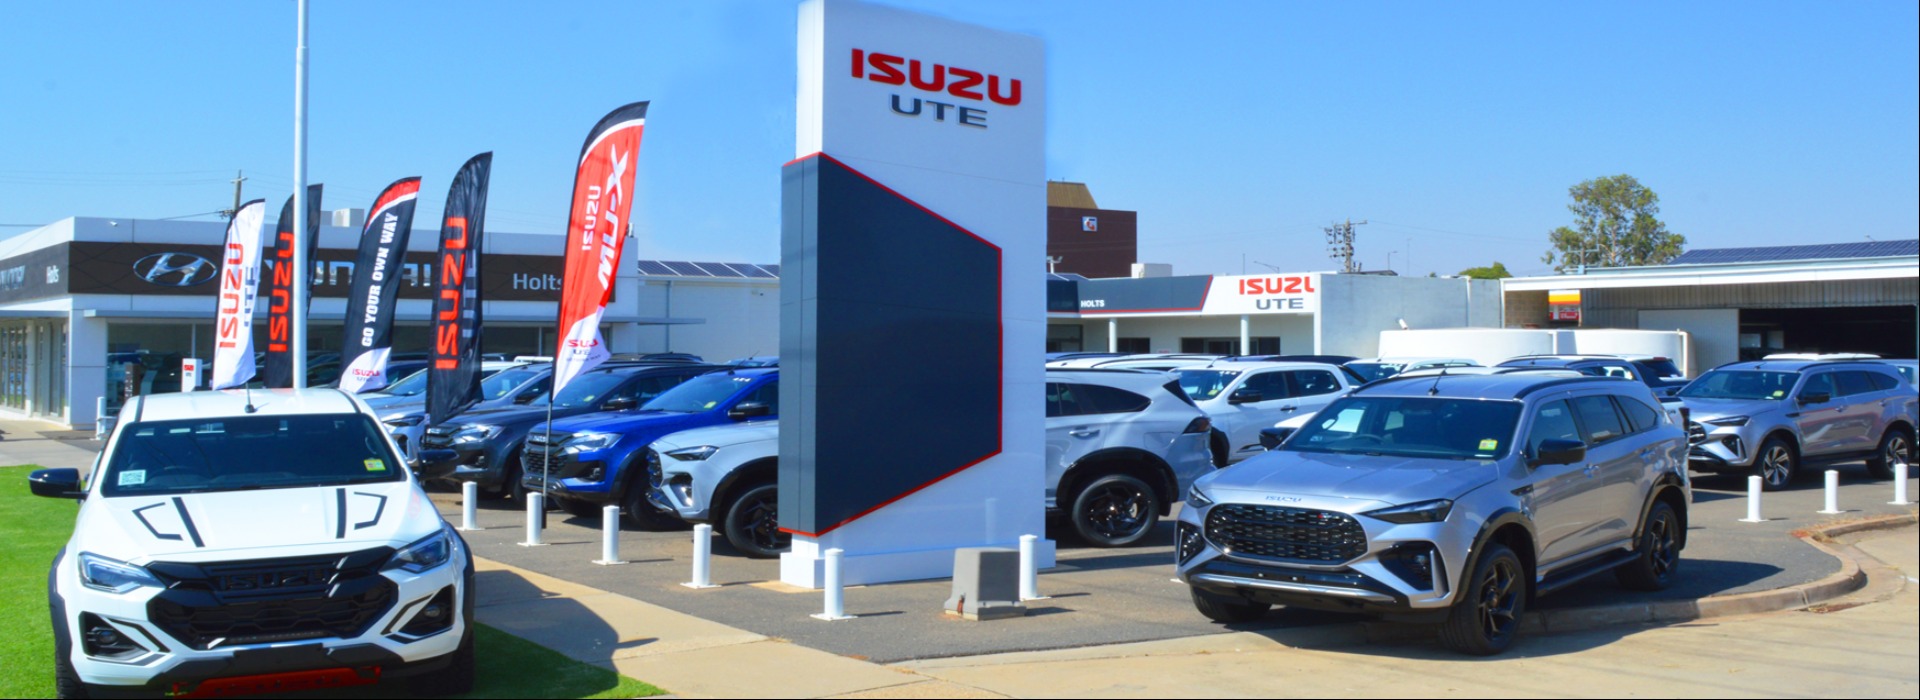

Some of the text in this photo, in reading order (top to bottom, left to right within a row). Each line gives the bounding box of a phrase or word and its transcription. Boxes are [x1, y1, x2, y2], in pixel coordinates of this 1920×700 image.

[852, 48, 1021, 105] ISUZU
[890, 94, 988, 128] UTE
[581, 185, 601, 251] ISUZU
[219, 243, 243, 348] ISUZU
[269, 232, 294, 352] ISUZU
[361, 212, 399, 347] GO YOUR OWN WAY
[435, 217, 468, 369] ISUZU
[1081, 300, 1105, 308] HOLTS
[1256, 298, 1303, 310] UTE
